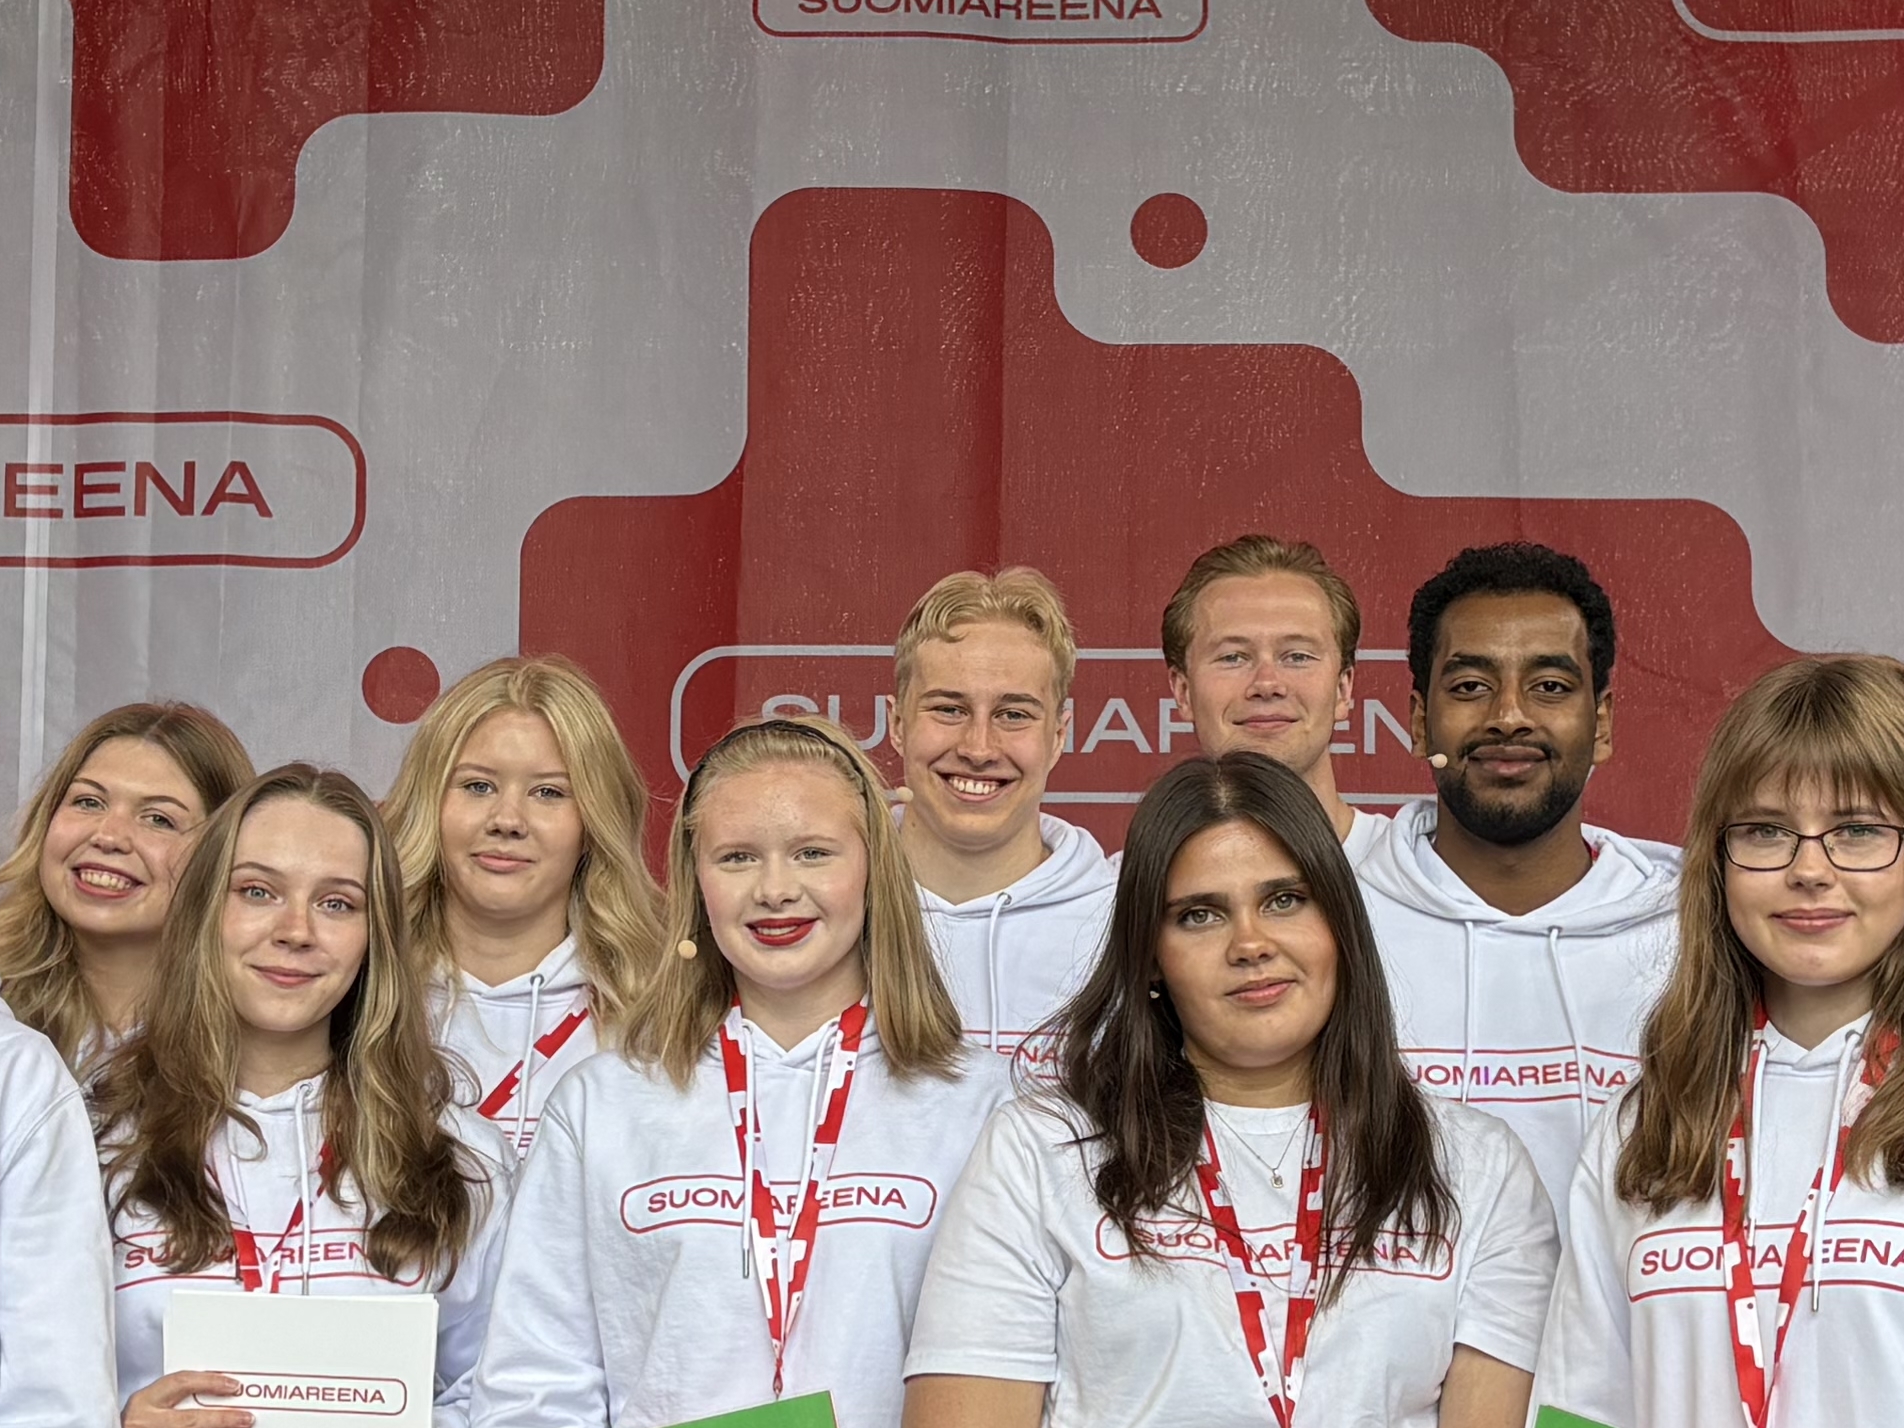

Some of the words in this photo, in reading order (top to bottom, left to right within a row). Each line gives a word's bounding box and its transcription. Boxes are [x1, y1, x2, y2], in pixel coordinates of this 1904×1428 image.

[1410, 1060, 1629, 1088] OMIAREENA
[647, 1186, 908, 1216] SUOMARENA
[234, 1383, 386, 1405] OMIAREENA
